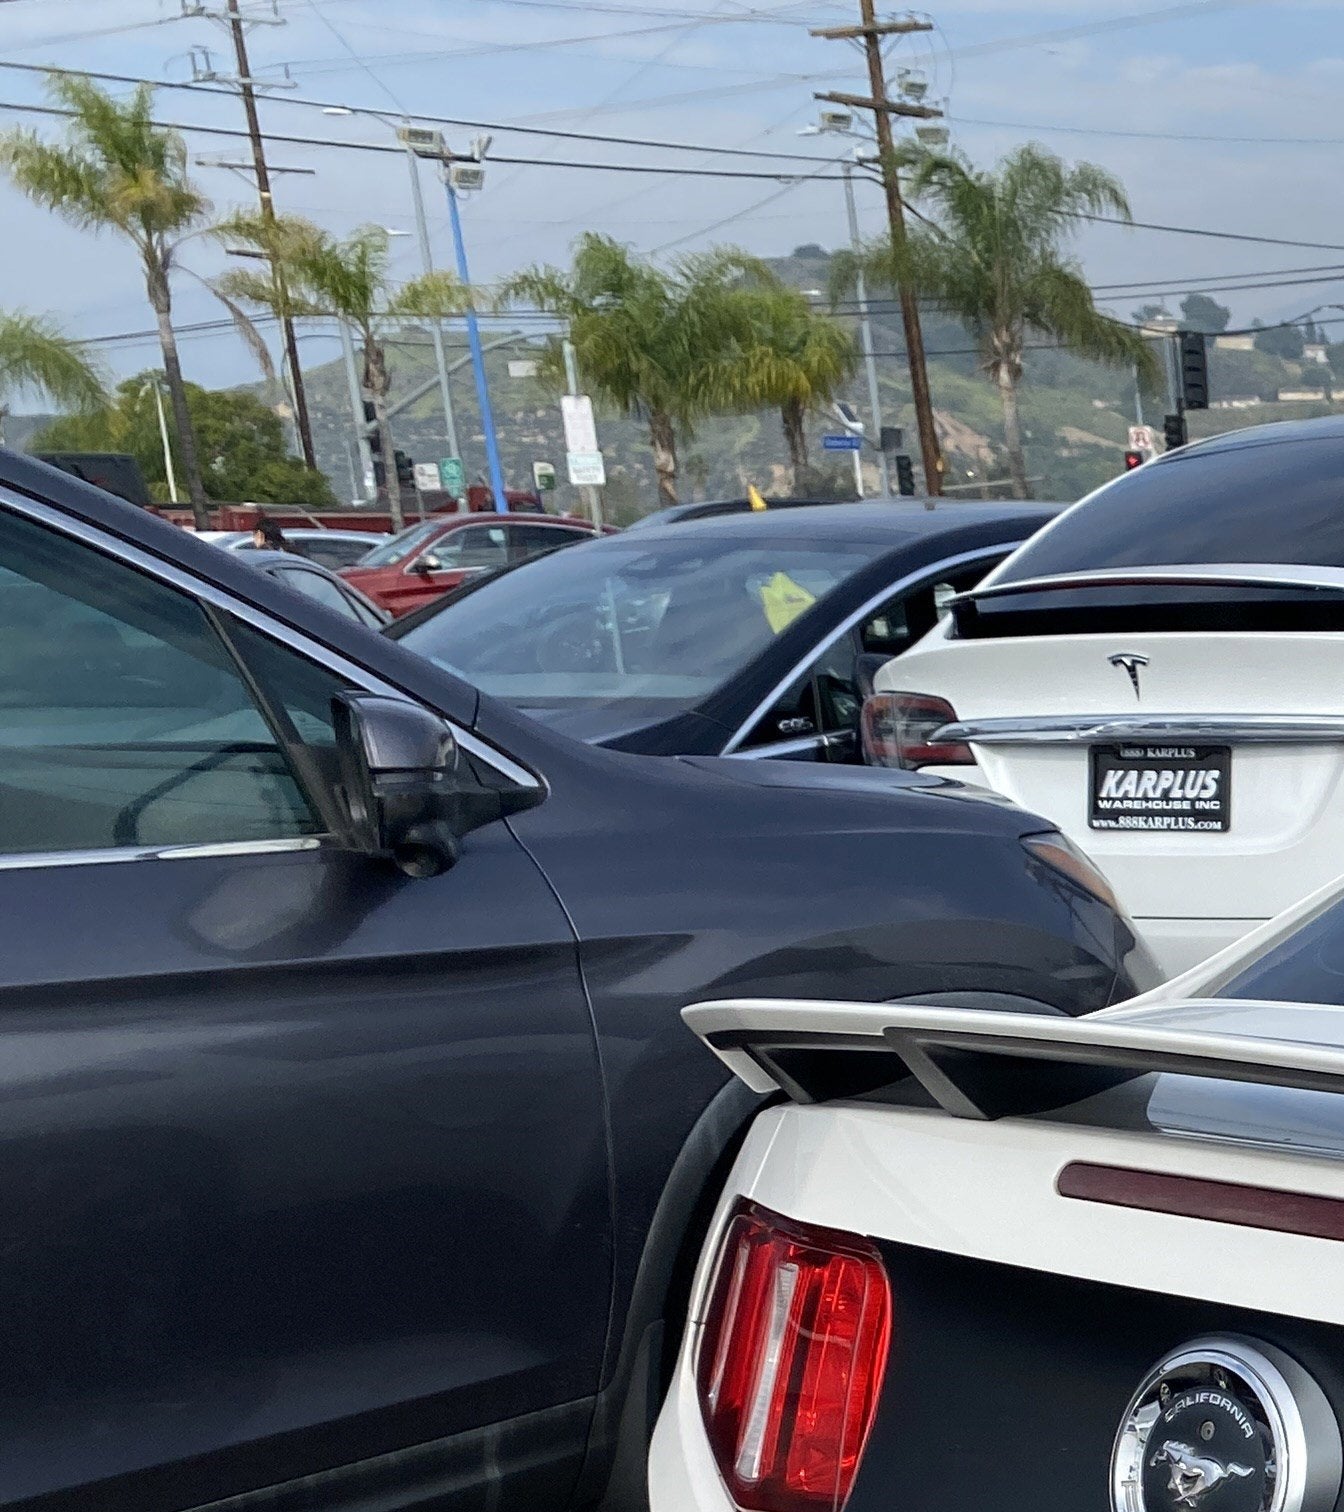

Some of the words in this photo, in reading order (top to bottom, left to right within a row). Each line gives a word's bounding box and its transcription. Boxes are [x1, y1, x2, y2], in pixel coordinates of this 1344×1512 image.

[1147, 747, 1196, 758] KARPLUS
[1099, 769, 1221, 799] KARPLUS
[1098, 800, 1192, 810] WAREHOUSE
[1194, 800, 1221, 809] INC
[1164, 1392, 1255, 1439] CALIFORNIA
